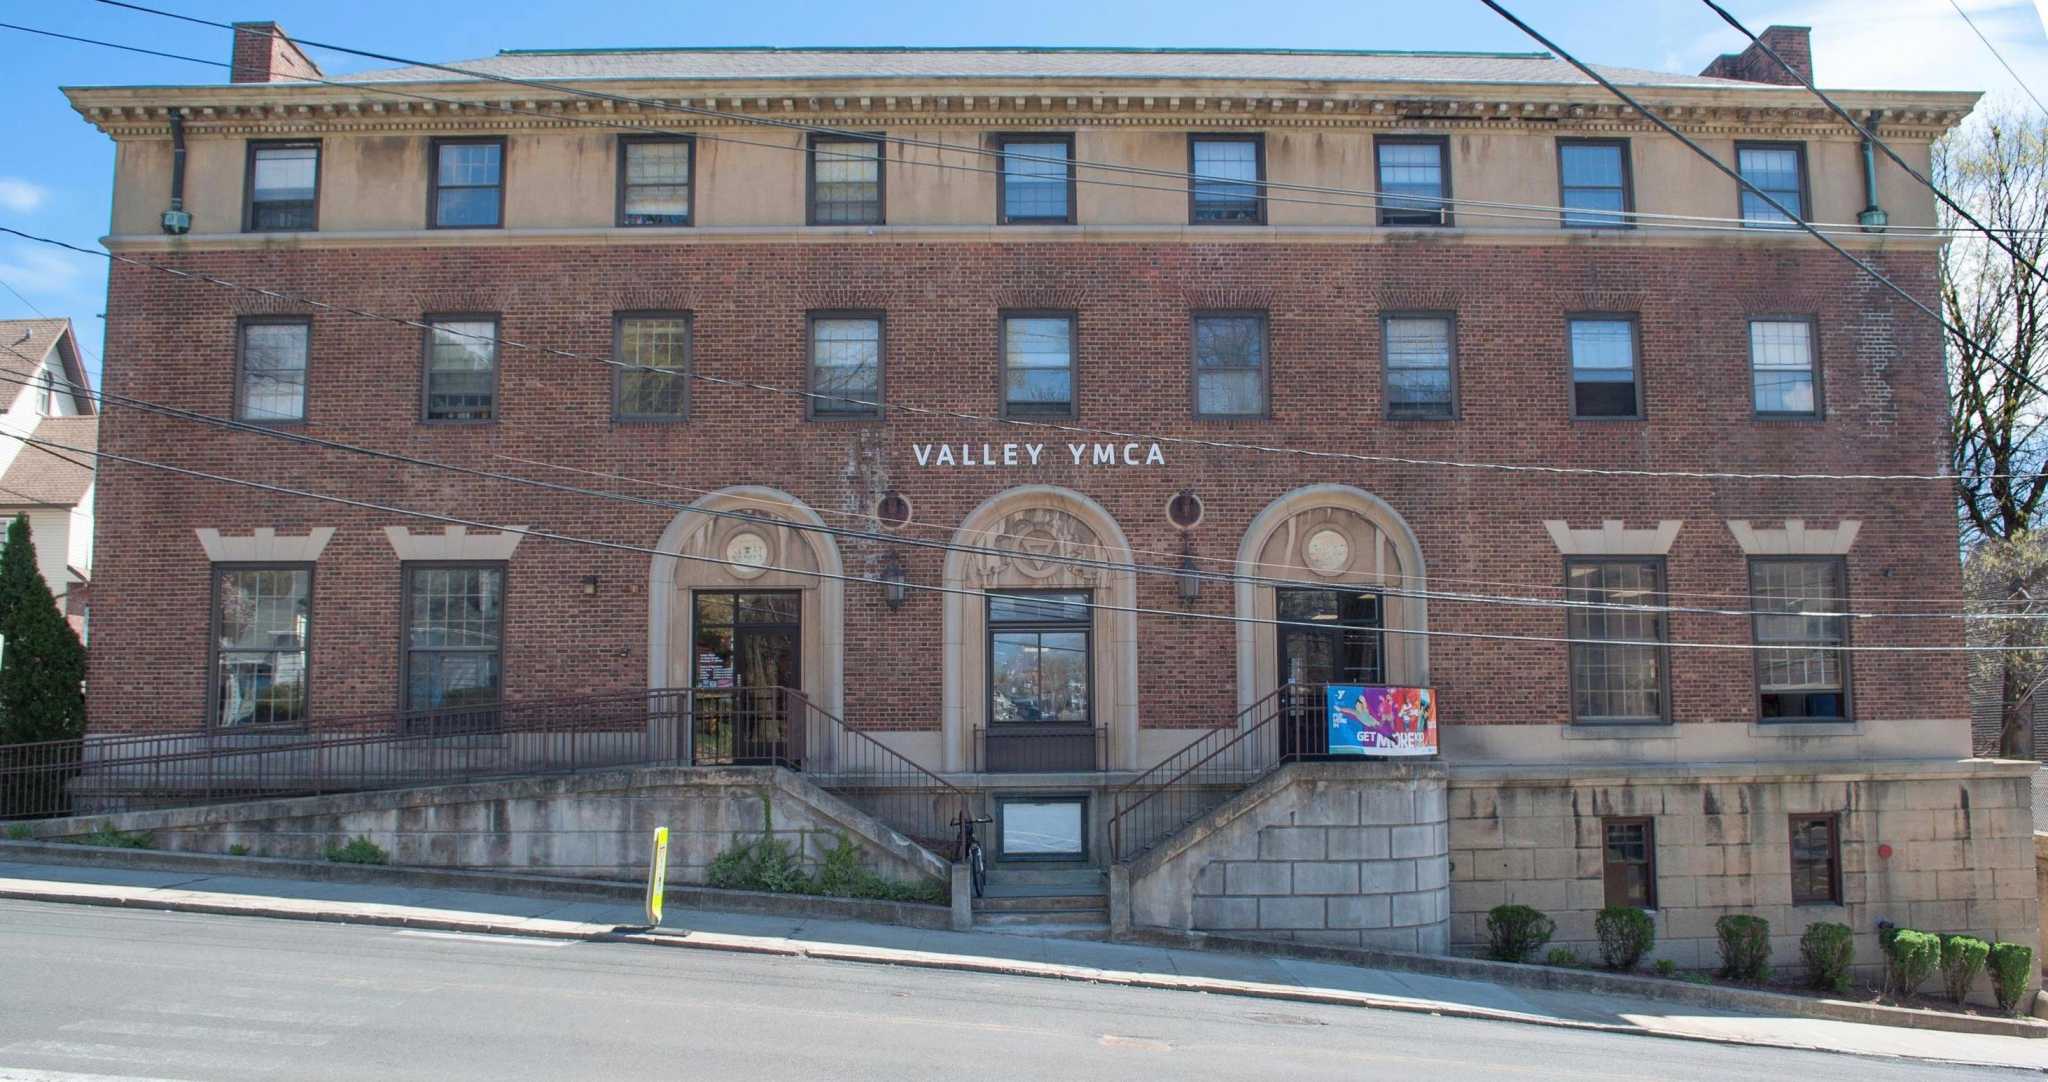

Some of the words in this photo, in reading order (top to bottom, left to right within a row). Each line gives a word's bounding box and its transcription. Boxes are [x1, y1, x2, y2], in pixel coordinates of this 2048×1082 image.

[912, 443, 1043, 466] VALLEY
[1068, 443, 1165, 465] YMCA
[1356, 731, 1376, 742] GET
